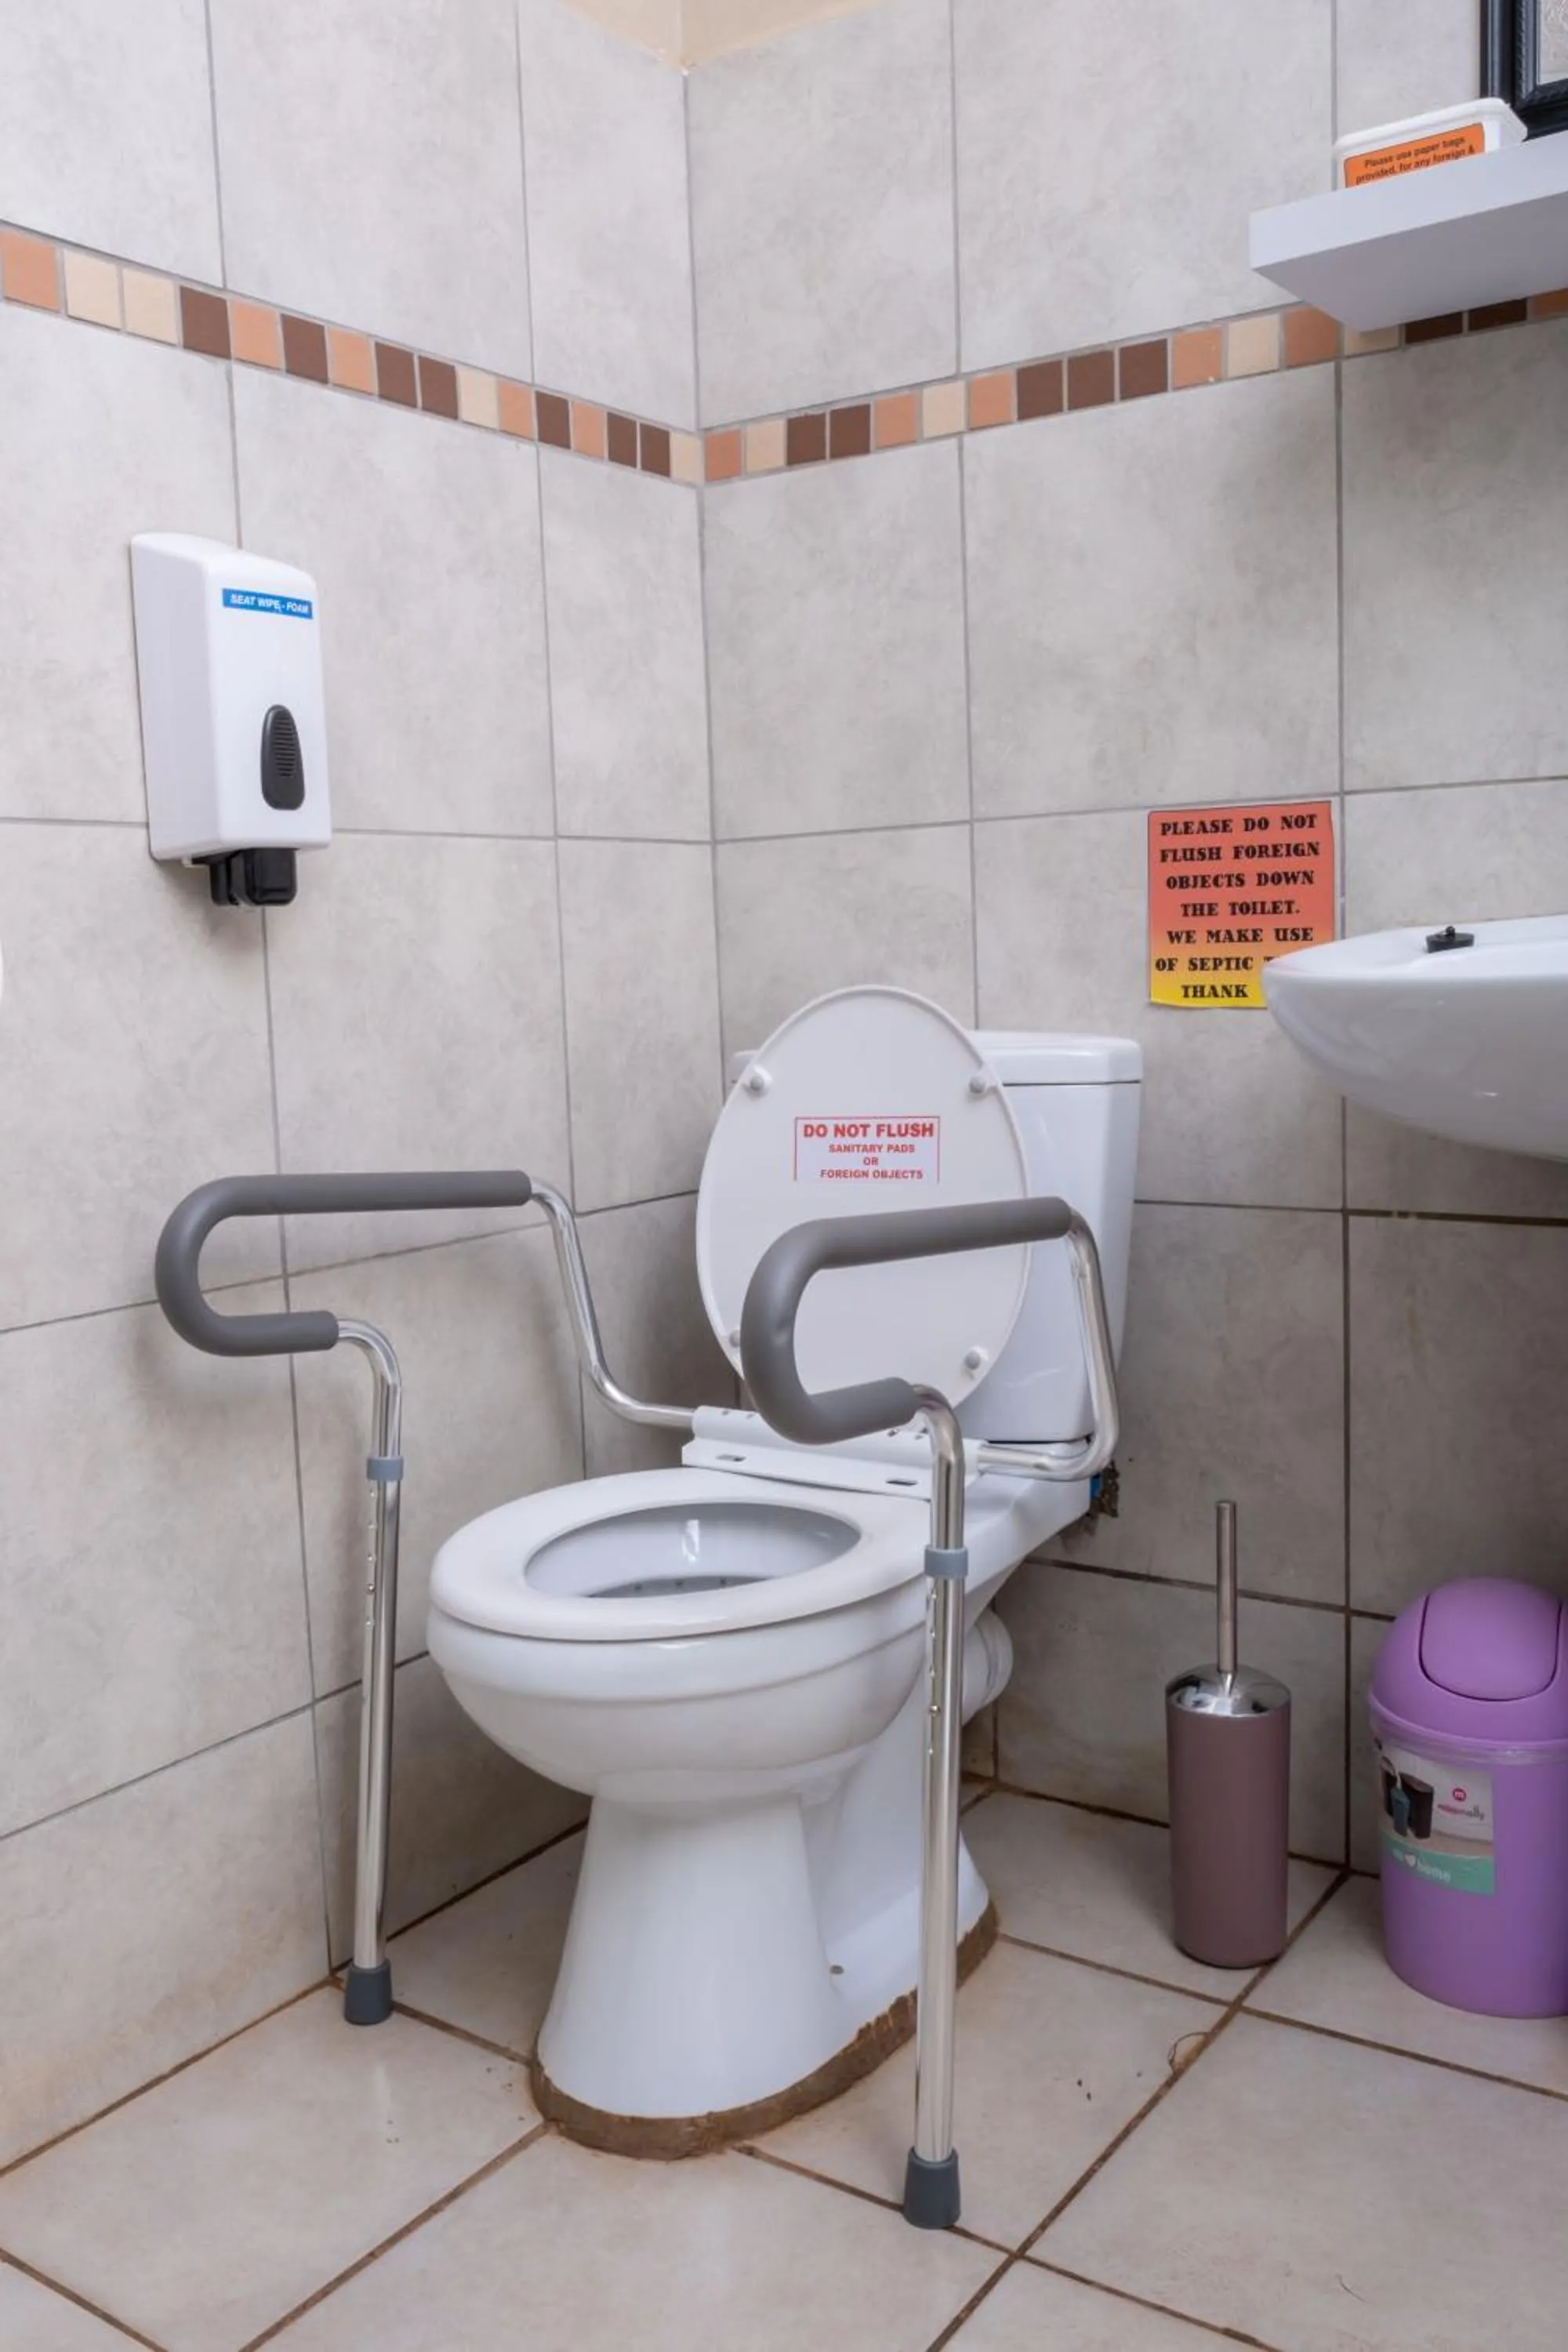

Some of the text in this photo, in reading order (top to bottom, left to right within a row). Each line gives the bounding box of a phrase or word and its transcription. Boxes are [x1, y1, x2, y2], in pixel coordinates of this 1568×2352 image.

[1364, 136, 1465, 168] Please use paper bags
[1399, 162, 1411, 172] for
[1414, 158, 1431, 169] any
[1433, 149, 1465, 162] foreign
[1468, 144, 1475, 154] &
[230, 593, 256, 605] SEAT
[286, 601, 309, 613] FOAM
[1160, 814, 1317, 836] PLEASE DO NOT
[1160, 842, 1320, 862] FLUSH FOREIGN
[1167, 870, 1314, 890] OBJECTS DOWN
[1181, 900, 1300, 916] THE TOILET.
[1167, 927, 1313, 944] WE MAKE USE
[1156, 958, 1178, 972] OF
[1188, 957, 1254, 971] SEPTIC
[1181, 985, 1249, 998] THANK
[803, 1123, 934, 1138] DO NOT FLUSH
[829, 1144, 915, 1153] SANITARY PADS
[862, 1156, 879, 1166] OR
[820, 1169, 924, 1180] FOREIGN OBJECTS
